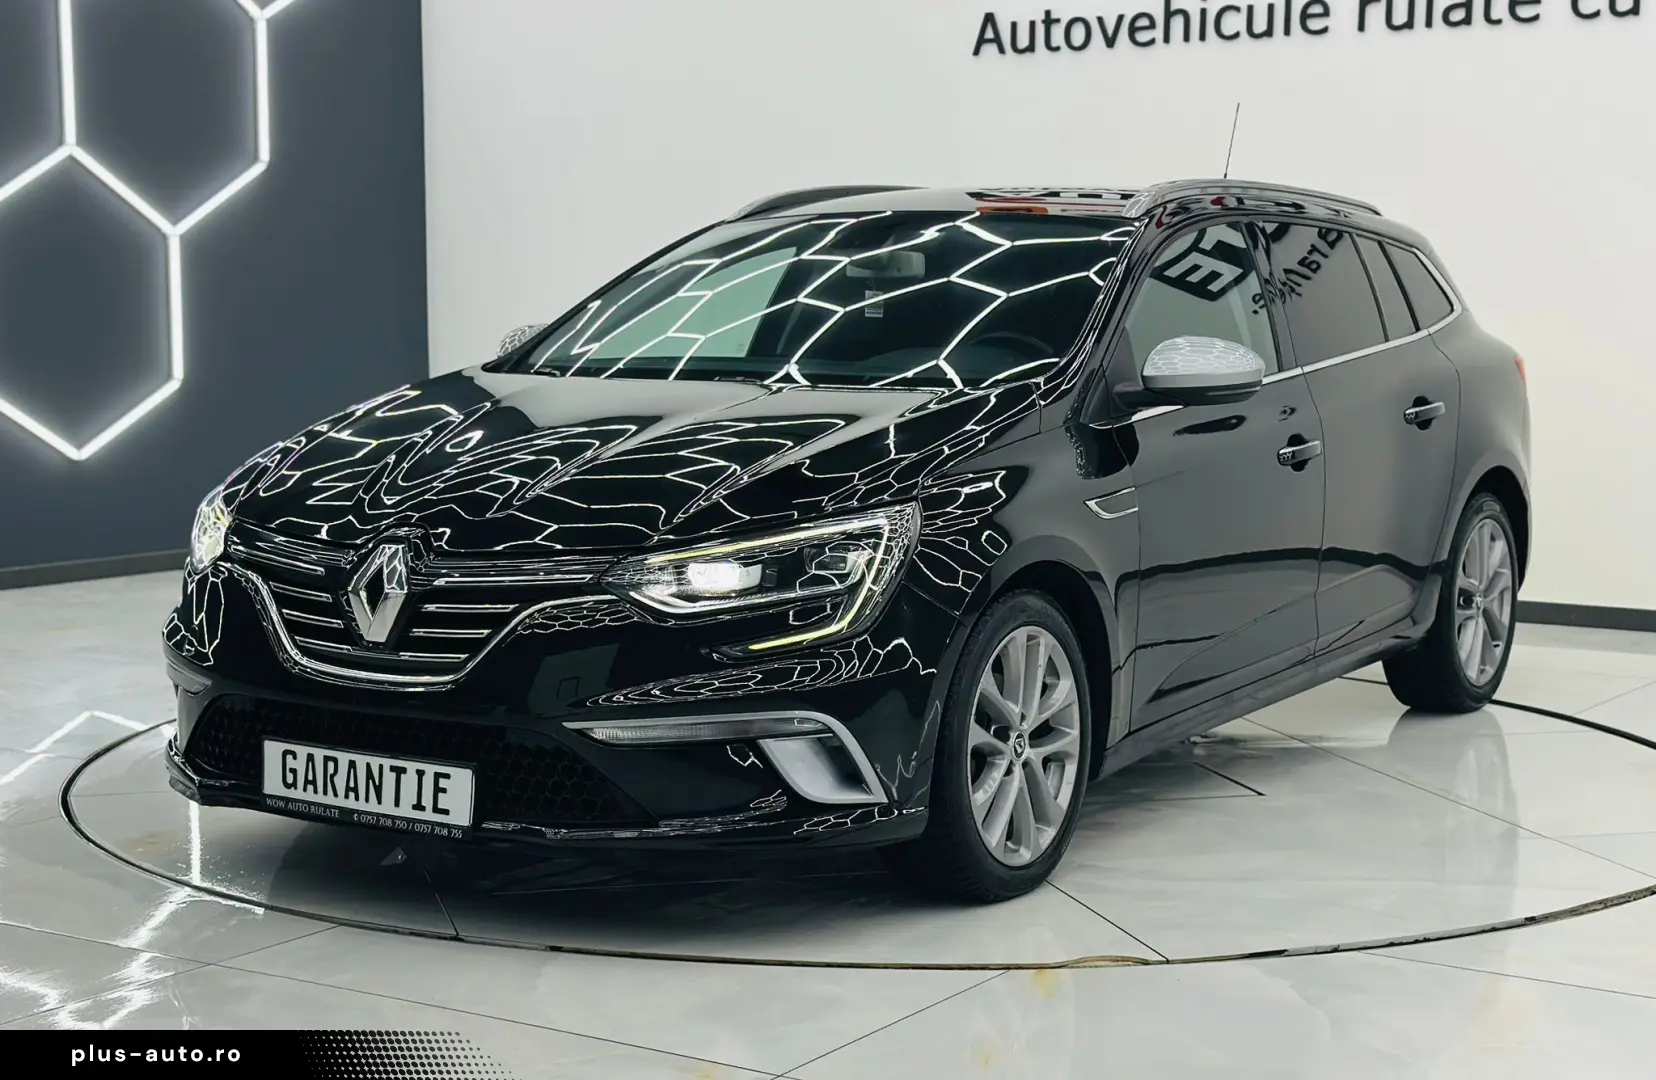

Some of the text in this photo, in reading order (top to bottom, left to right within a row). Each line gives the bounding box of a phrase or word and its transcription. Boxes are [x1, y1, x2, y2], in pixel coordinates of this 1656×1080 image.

[972, 0, 1330, 56] Autovehicule
[281, 749, 451, 816] GARANTIE
[266, 797, 340, 818] WOW AUTO RULATE
[360, 814, 377, 825] 0757
[379, 818, 393, 827] 708
[394, 819, 408, 829] 750
[414, 823, 432, 834] 0757
[433, 827, 448, 836] 708
[450, 828, 463, 839] 755
